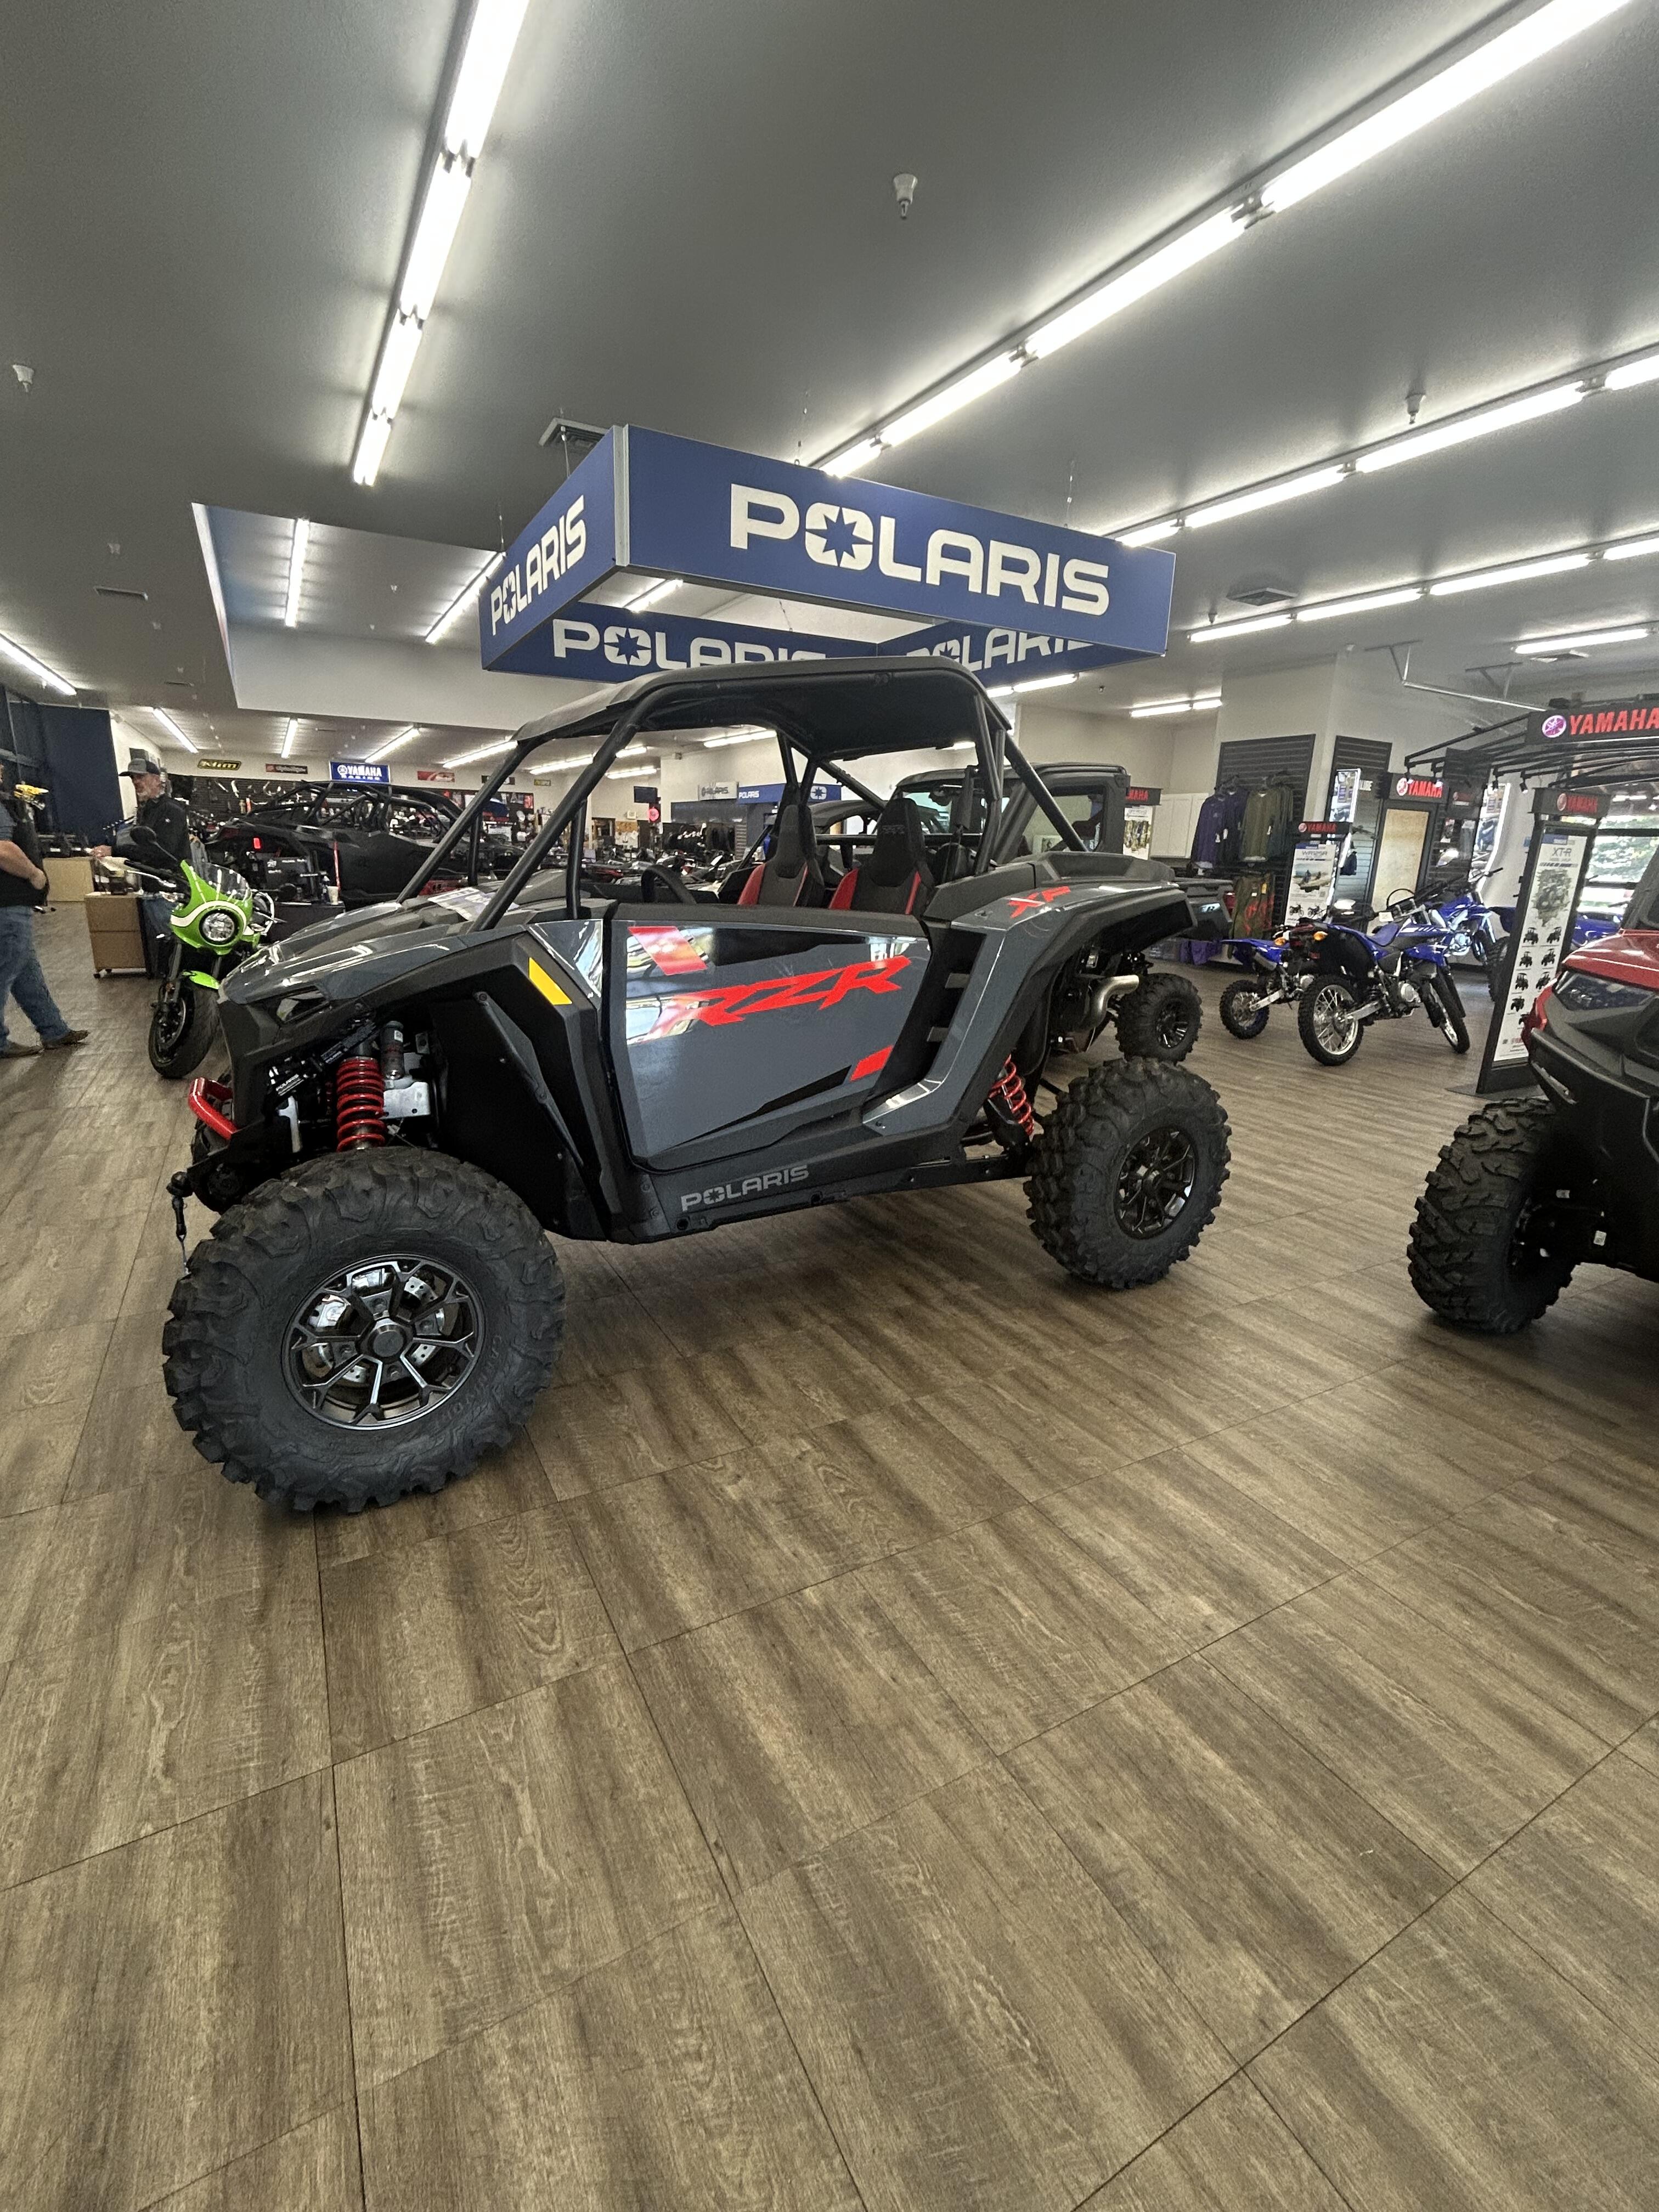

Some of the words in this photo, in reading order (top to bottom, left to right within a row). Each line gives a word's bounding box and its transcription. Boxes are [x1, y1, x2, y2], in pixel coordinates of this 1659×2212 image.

[491, 494, 586, 635] POLARIS
[730, 483, 1109, 616] POLARIS
[553, 619, 826, 669] POLAR
[1570, 707, 1659, 736] YAMAHA
[347, 765, 382, 777] YAMAHA
[738, 791, 760, 799] POLARIS
[1307, 823, 1338, 833] YAMAHA
[643, 955, 912, 1043] RZR
[681, 1165, 810, 1212] POLARIS
